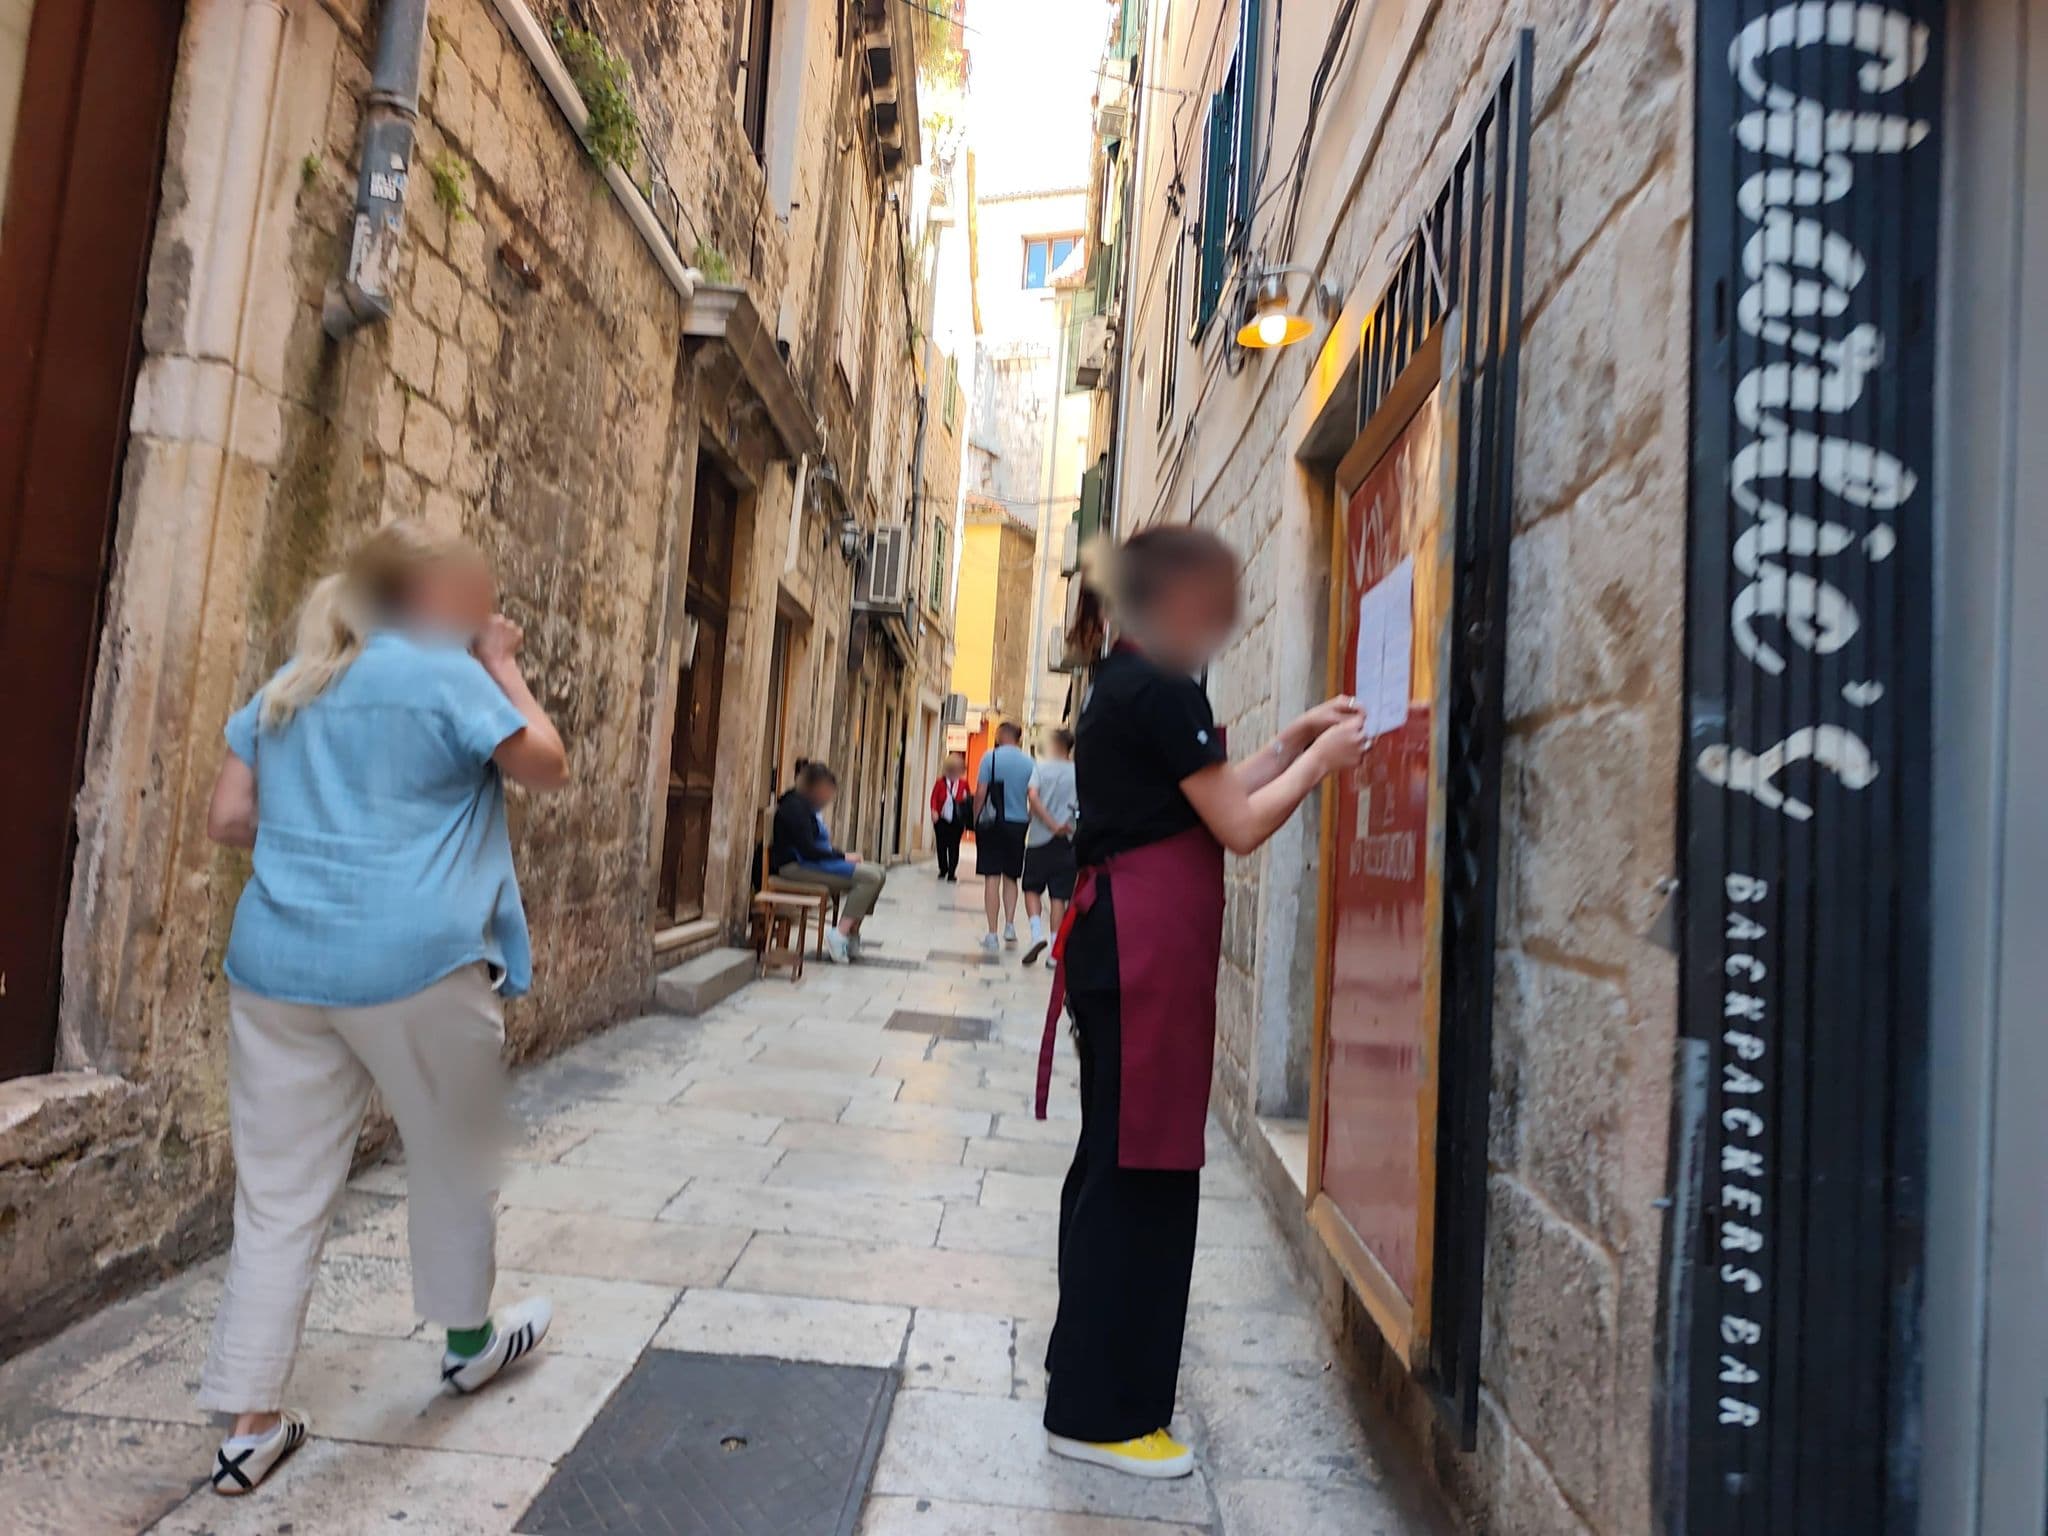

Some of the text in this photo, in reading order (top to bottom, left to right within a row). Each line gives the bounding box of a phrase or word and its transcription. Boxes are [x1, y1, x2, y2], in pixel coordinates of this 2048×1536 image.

[1696, 1, 1930, 821] Charlie's
[1718, 872, 1768, 1427] BACKPACKERS BAR
